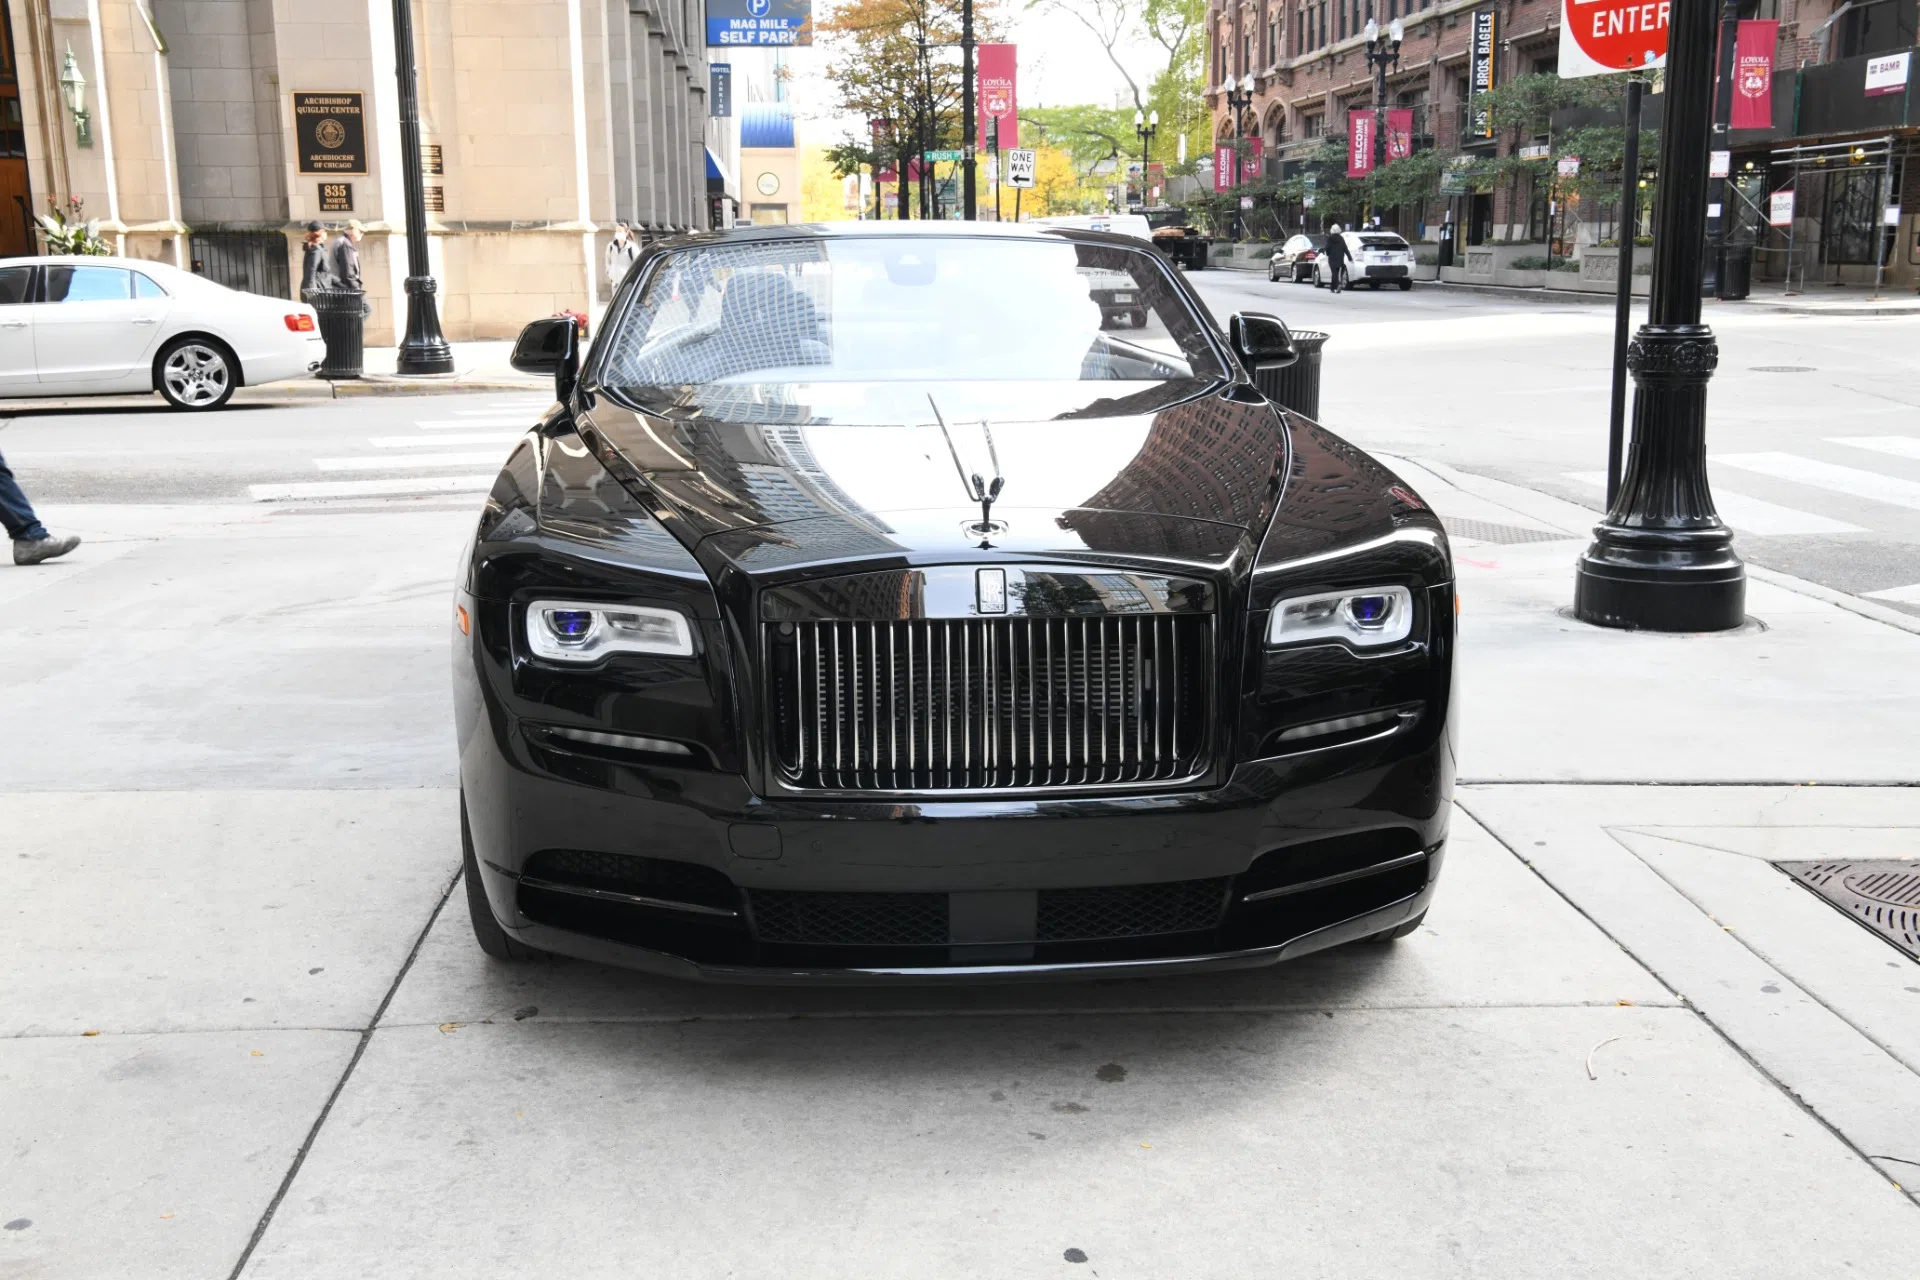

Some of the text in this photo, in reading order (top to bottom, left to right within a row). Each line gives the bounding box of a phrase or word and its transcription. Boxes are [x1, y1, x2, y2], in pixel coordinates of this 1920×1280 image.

[730, 19, 788, 29] MAG MILE
[1592, 2, 1670, 38] ENTER
[720, 31, 798, 43] SELF PARK
[1478, 14, 1492, 54] BAGELS
[1477, 57, 1490, 86] BROS.
[304, 97, 352, 105] ARCHBISHOP
[297, 106, 360, 115] QUIGLEY CENTER
[1355, 118, 1364, 169] WELCOME
[932, 152, 952, 161] RUSH
[1012, 152, 1032, 162] ONE
[1011, 163, 1032, 172] WAY
[324, 185, 346, 197] 835
